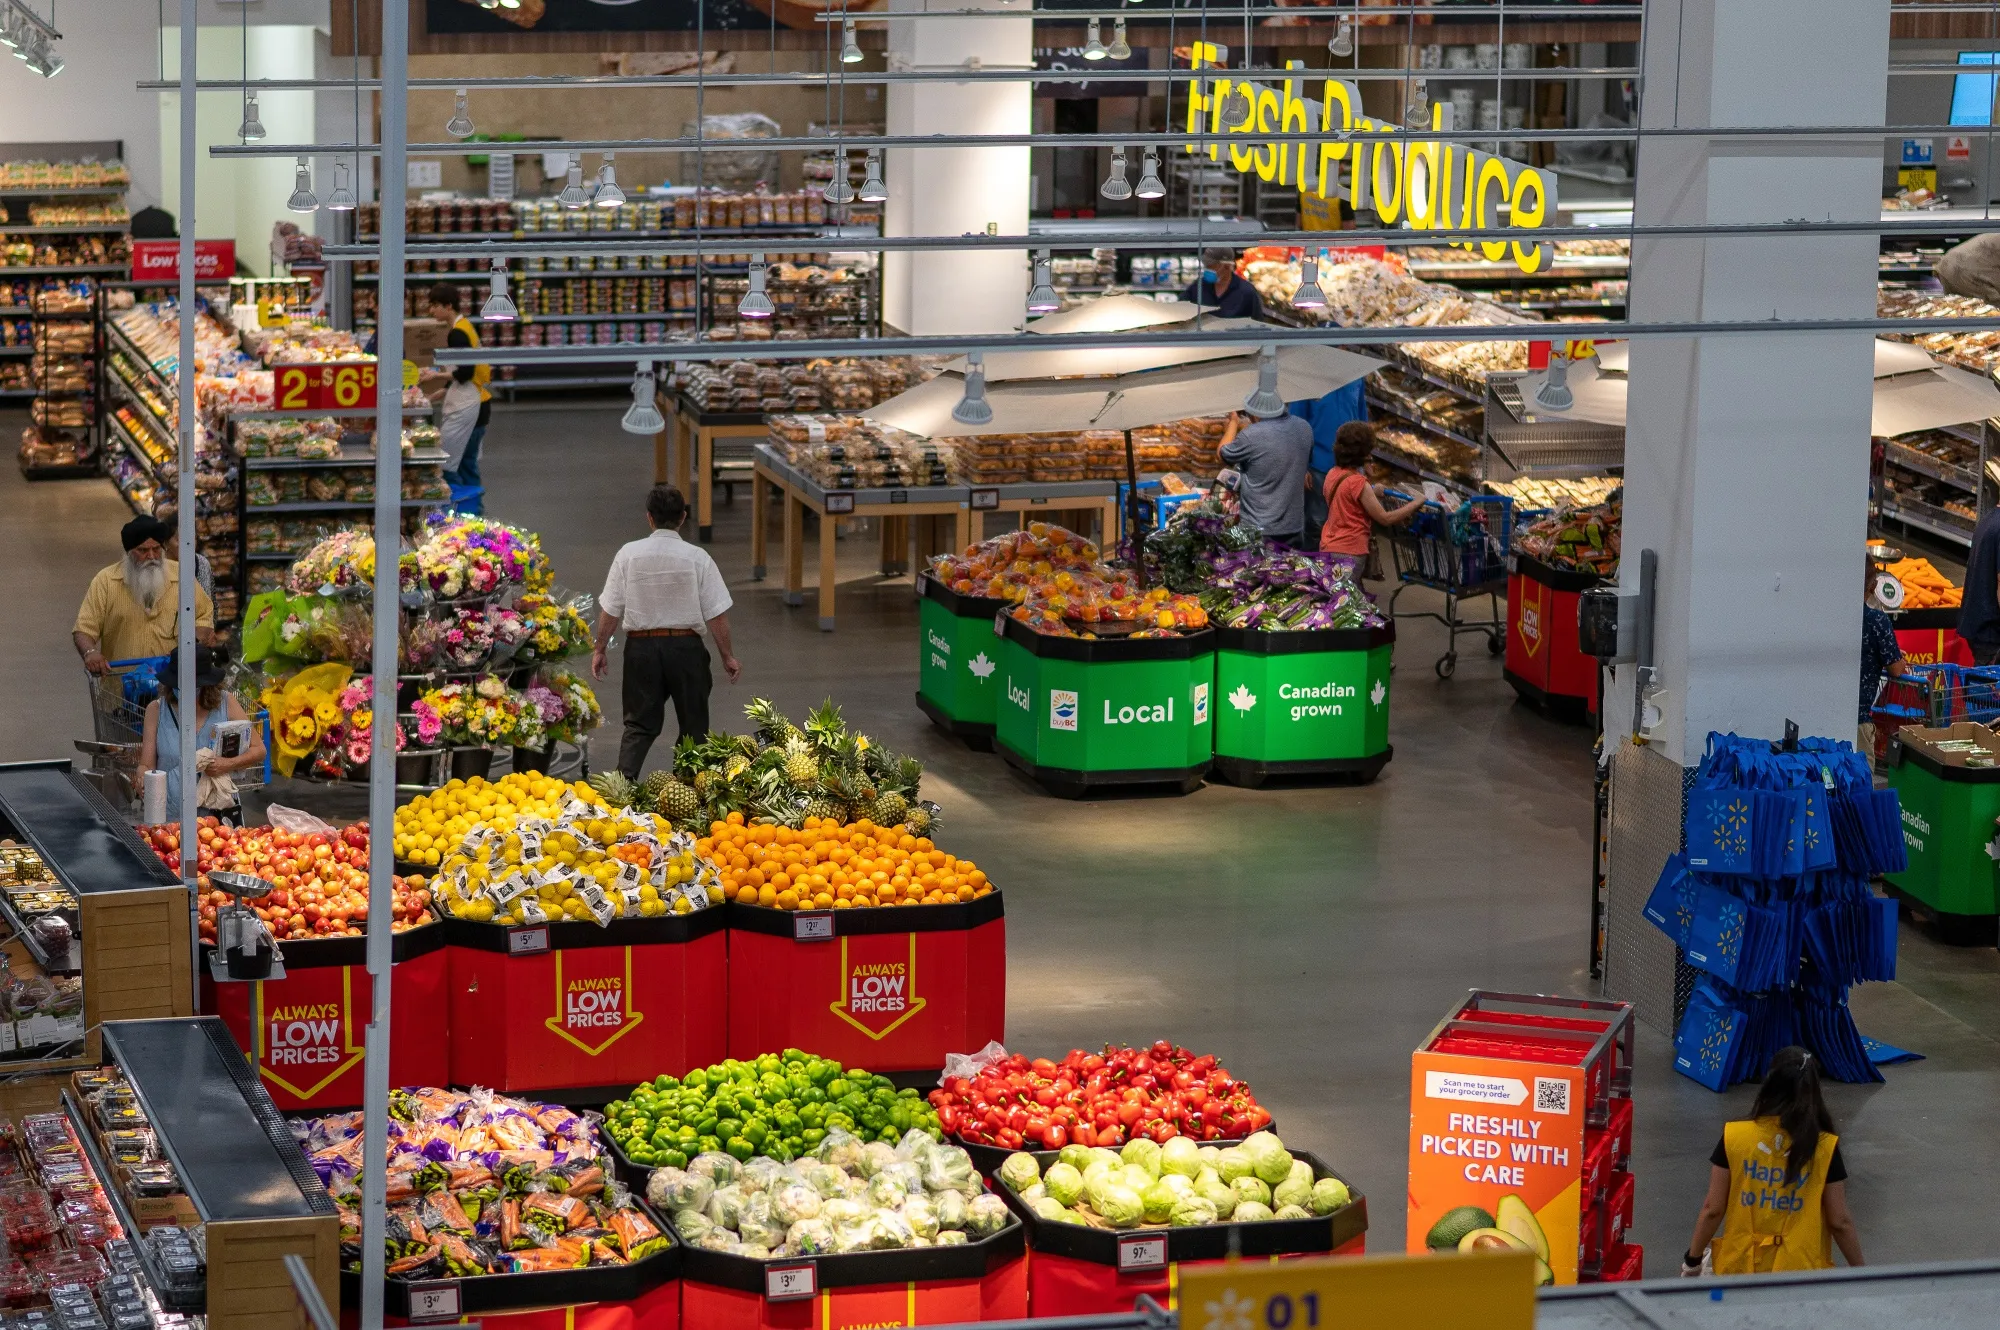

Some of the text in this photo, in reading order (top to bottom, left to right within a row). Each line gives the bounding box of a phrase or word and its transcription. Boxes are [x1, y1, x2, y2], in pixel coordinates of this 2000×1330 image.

[1186, 41, 1546, 274] Fresh Produce
[142, 253, 174, 268] Low
[282, 368, 308, 408] 2
[309, 378, 320, 388] for
[322, 367, 376, 406] $65
[928, 628, 950, 655] Canadian
[932, 652, 946, 670] grown
[1905, 653, 1934, 664] WAYS
[1008, 675, 1030, 712] Local
[1278, 682, 1355, 699] Canadian
[1104, 697, 1174, 724] Local
[1290, 704, 1342, 722] grown
[1898, 801, 1930, 836] anadian
[1903, 831, 1924, 852] rown
[852, 963, 906, 976] ALWAYS
[568, 978, 622, 992] ALWAYS
[852, 976, 906, 998] LOW
[568, 990, 622, 1013] LOW
[852, 996, 905, 1012] PRICES
[272, 1004, 338, 1021] ALWAYS
[568, 1012, 622, 1028] PRICES
[272, 1020, 338, 1047] LOW
[272, 1046, 340, 1066] PRICES
[1439, 1086, 1510, 1098] your grocery order
[1444, 1078, 1462, 1087] Scan
[1449, 1113, 1542, 1139] FRESHLY
[1421, 1134, 1569, 1166] PICKED WITH
[1464, 1164, 1525, 1186] CARE
[1743, 1160, 1810, 1190] Hapy
[1741, 1190, 1756, 1207] to
[1266, 1292, 1319, 1328] 01
